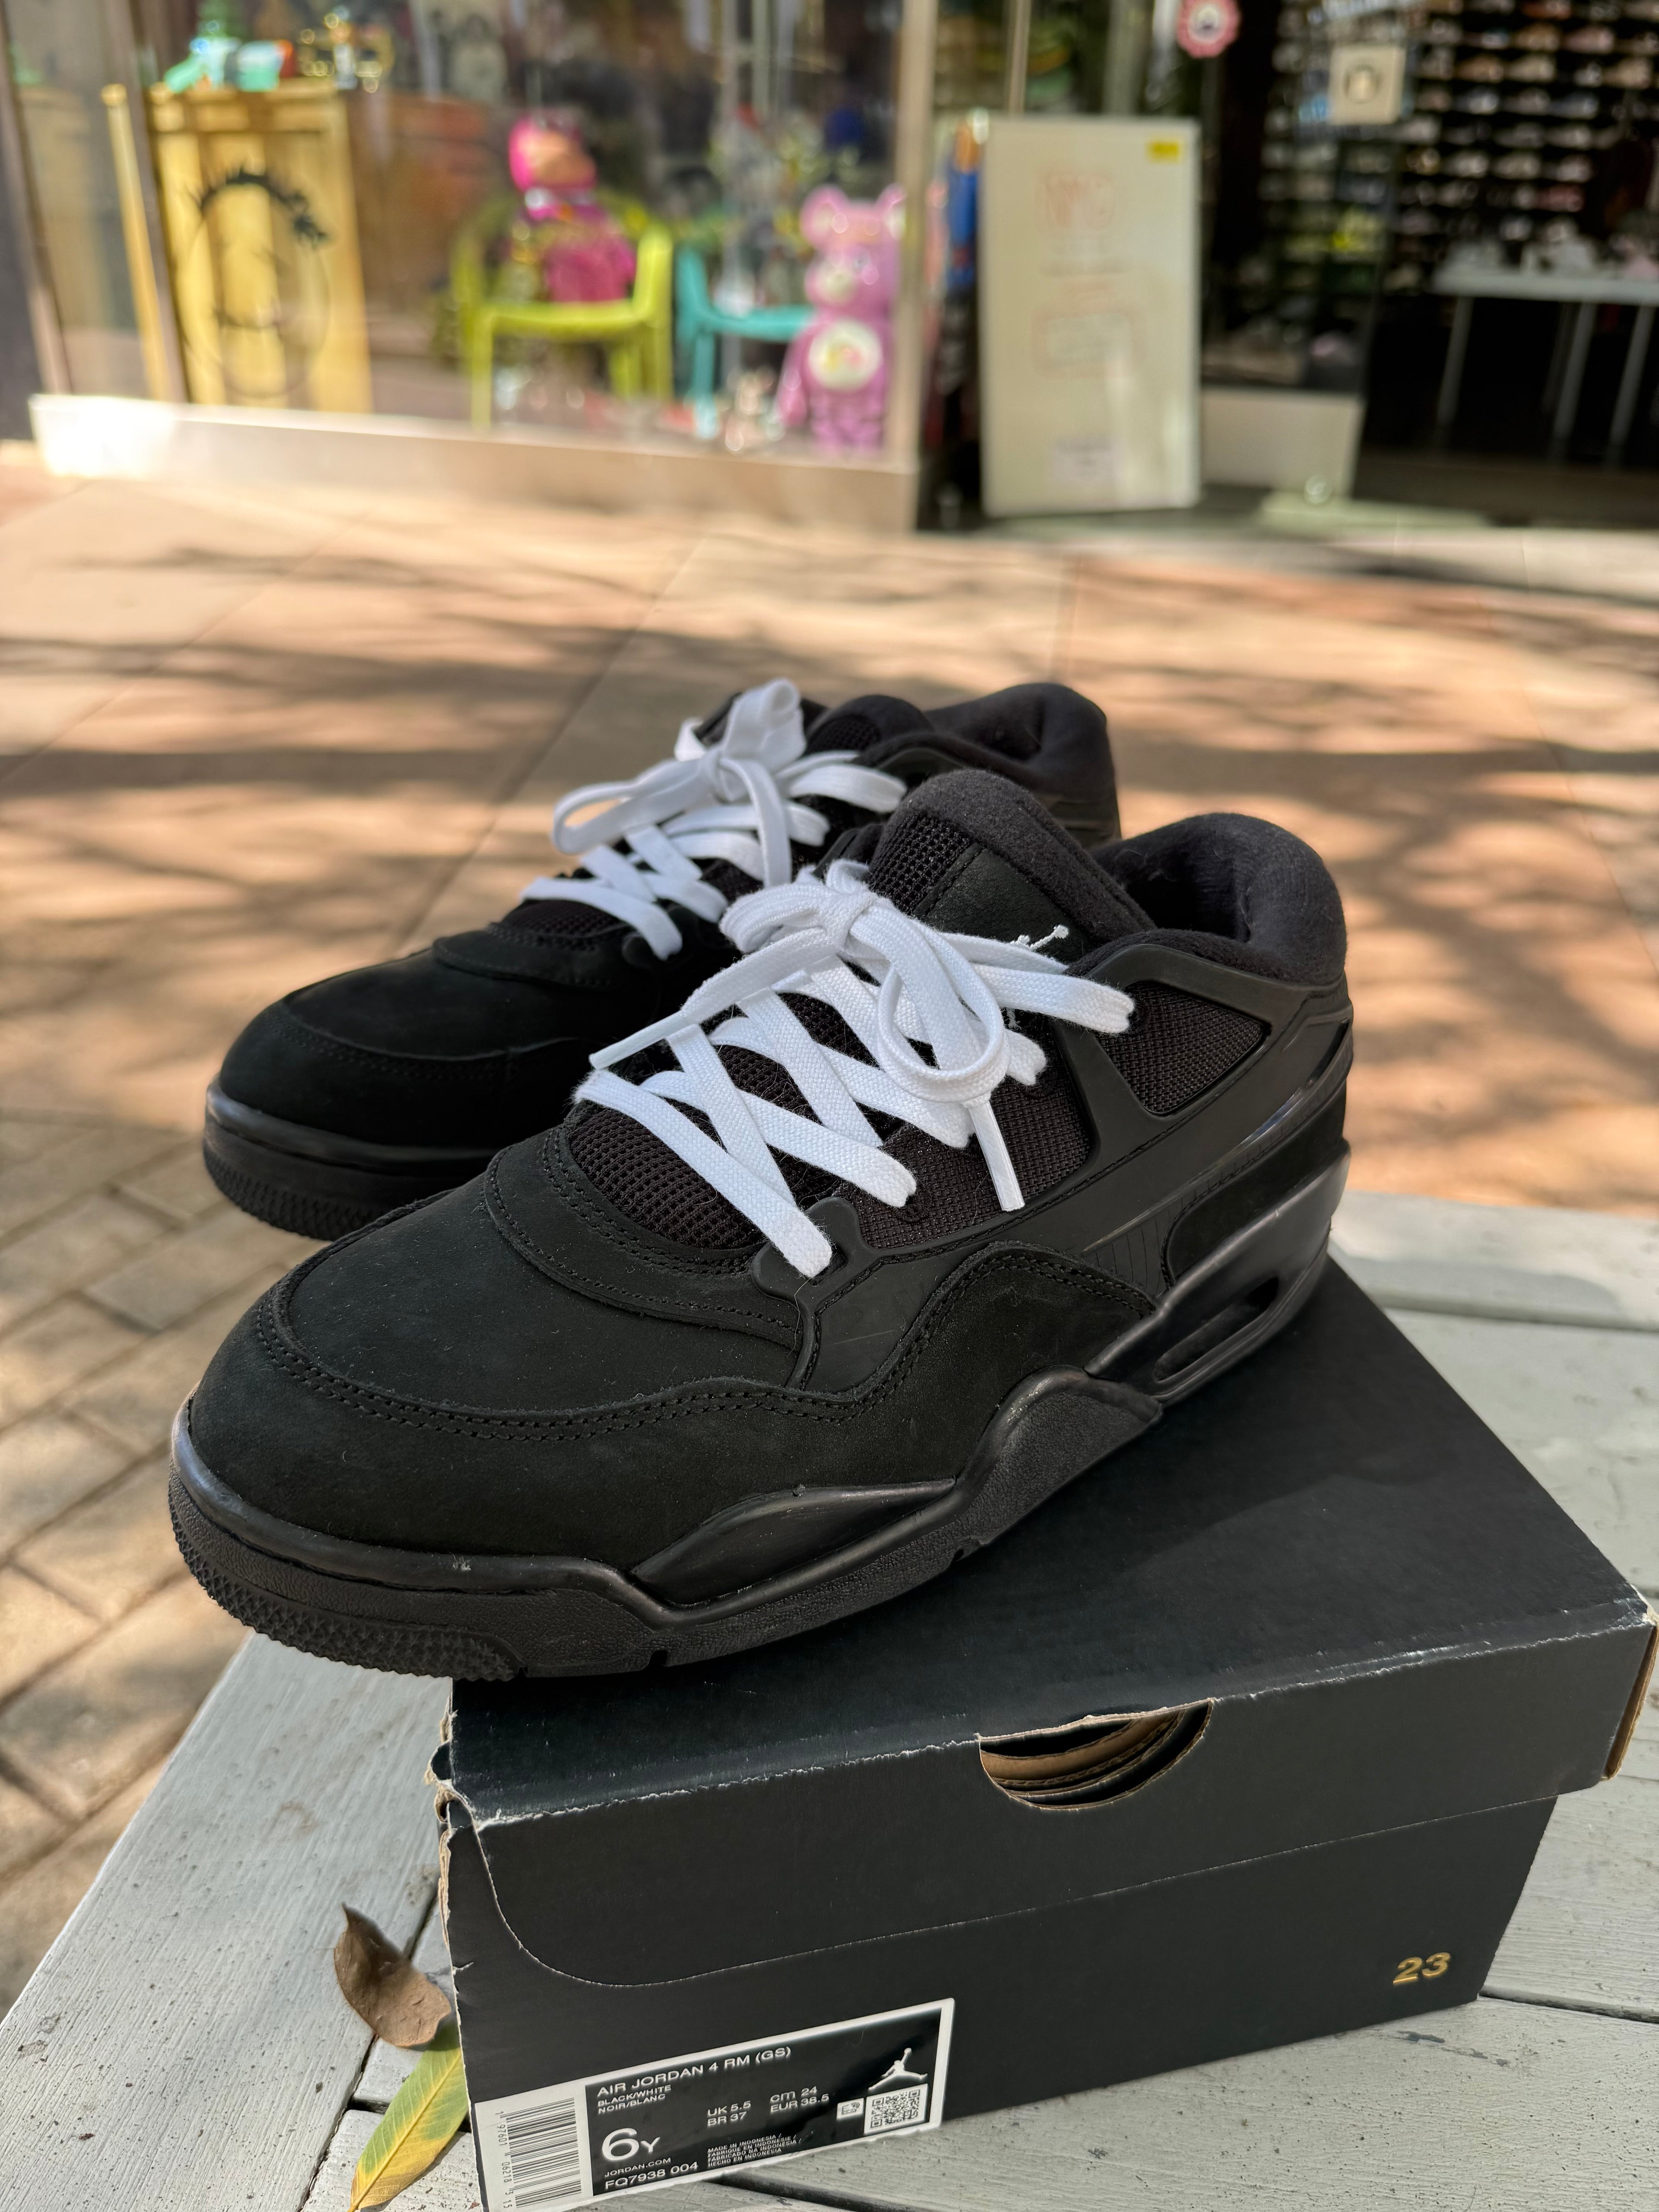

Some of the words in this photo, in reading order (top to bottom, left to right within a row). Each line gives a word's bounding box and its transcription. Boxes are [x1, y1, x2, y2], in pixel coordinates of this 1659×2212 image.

[1392, 1951, 1452, 1984] 23
[597, 2082, 626, 2097] AIR
[631, 2065, 704, 2089] JORDAN
[709, 2062, 718, 2071] 4
[724, 2055, 750, 2069] RM
[756, 2047, 791, 2064] (GS)
[597, 2085, 671, 2107] BLACK/WHITE
[801, 2086, 817, 2097] 24
[597, 2094, 666, 2114] NOIR/BLANC
[707, 2105, 728, 2117] UK
[731, 2100, 751, 2112] 5.5
[770, 2100, 798, 2114] EUR
[801, 2093, 830, 2106] 38.5
[707, 2116, 727, 2127] BR
[730, 2111, 747, 2122] 37
[497, 2124, 508, 2146] 97601
[708, 2145, 728, 2153] MADE
[739, 2134, 776, 2146] INDONESIA
[708, 2147, 741, 2158] FABRIQUE
[755, 2136, 791, 2147] INDONESIE
[708, 2151, 746, 2163] FABRICADO
[760, 2139, 797, 2152] INDONESIA
[605, 2157, 671, 2177] JORDAN.COM
[708, 2159, 731, 2168] HECHO
[744, 2148, 782, 2160] INDONESIA
[502, 2161, 512, 2183] 06218
[605, 2169, 666, 2190] FQ7938
[671, 2161, 699, 2174] 004
[502, 2199, 513, 2209] 15
